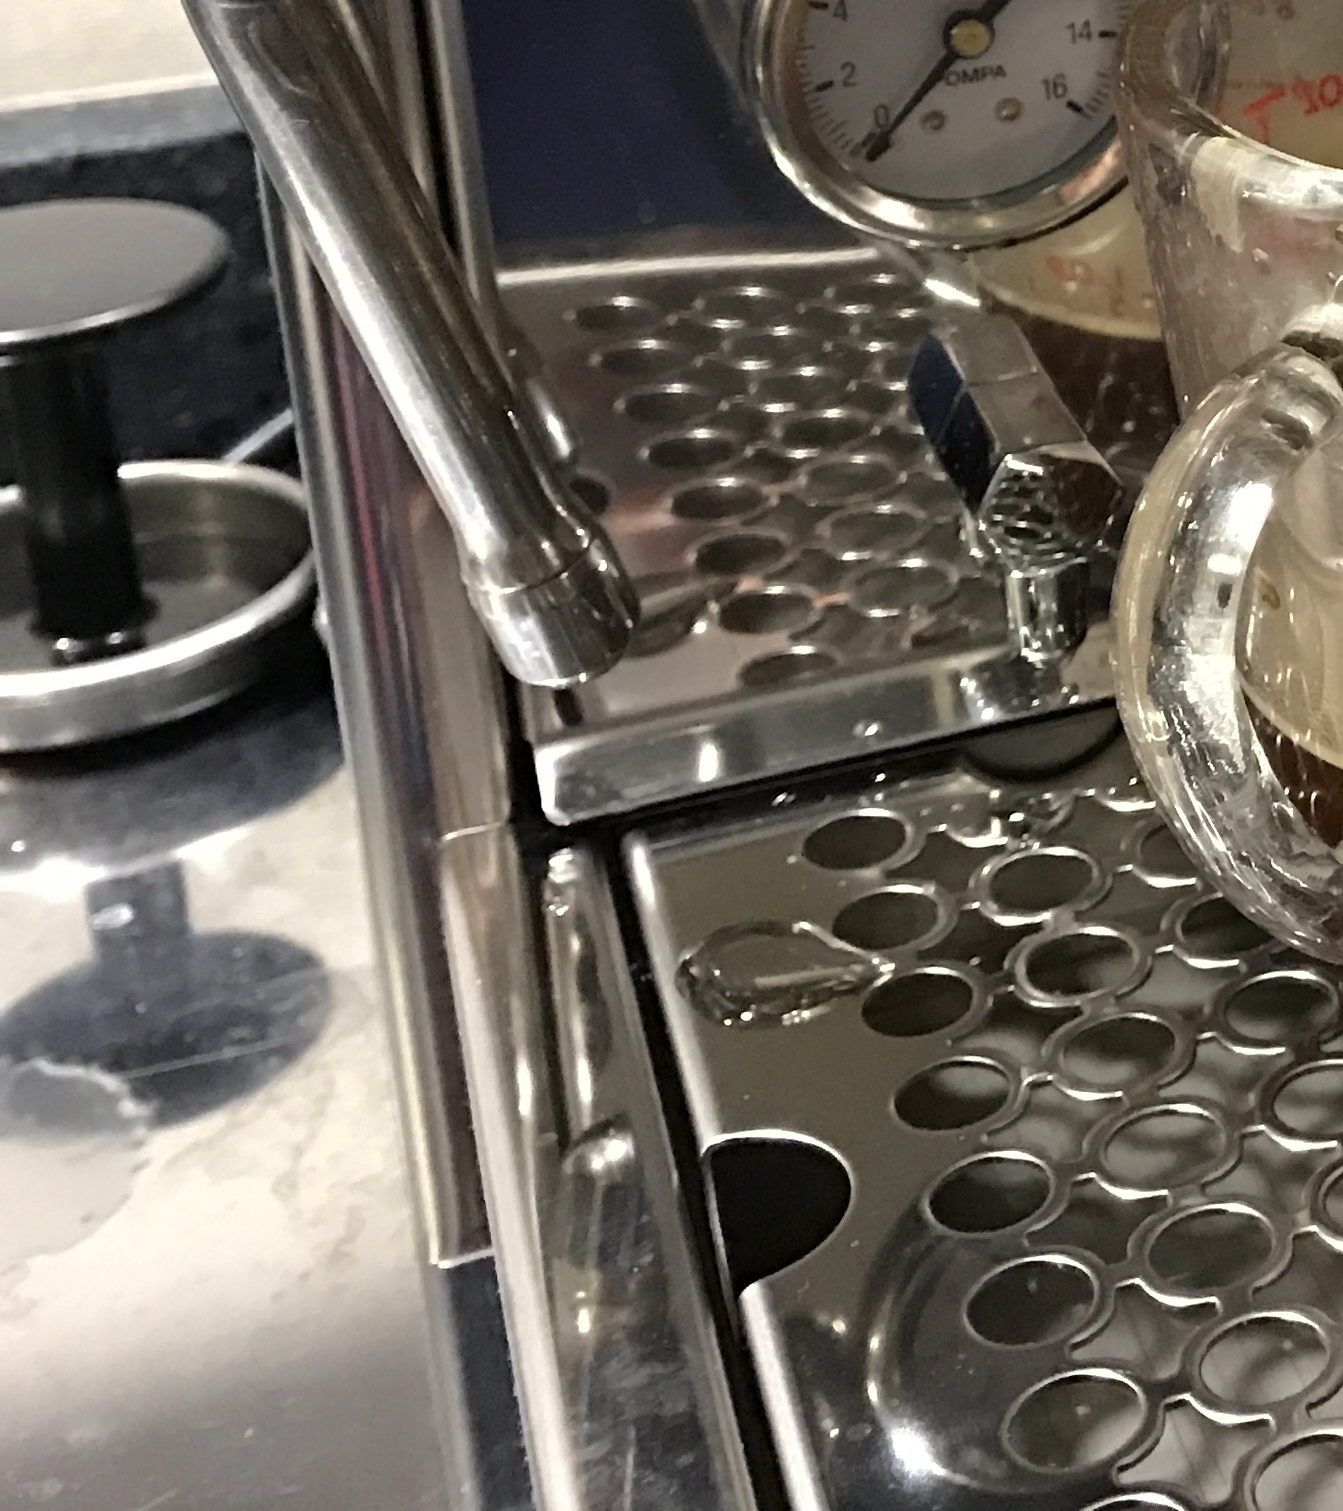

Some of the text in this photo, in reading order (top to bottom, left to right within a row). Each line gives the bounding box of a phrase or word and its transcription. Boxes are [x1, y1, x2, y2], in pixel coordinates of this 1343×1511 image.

[1065, 19, 1094, 45] 14
[841, 62, 858, 88] 2
[938, 64, 1007, 87] OMPA
[1042, 74, 1068, 100] 16
[873, 103, 890, 127] 0
